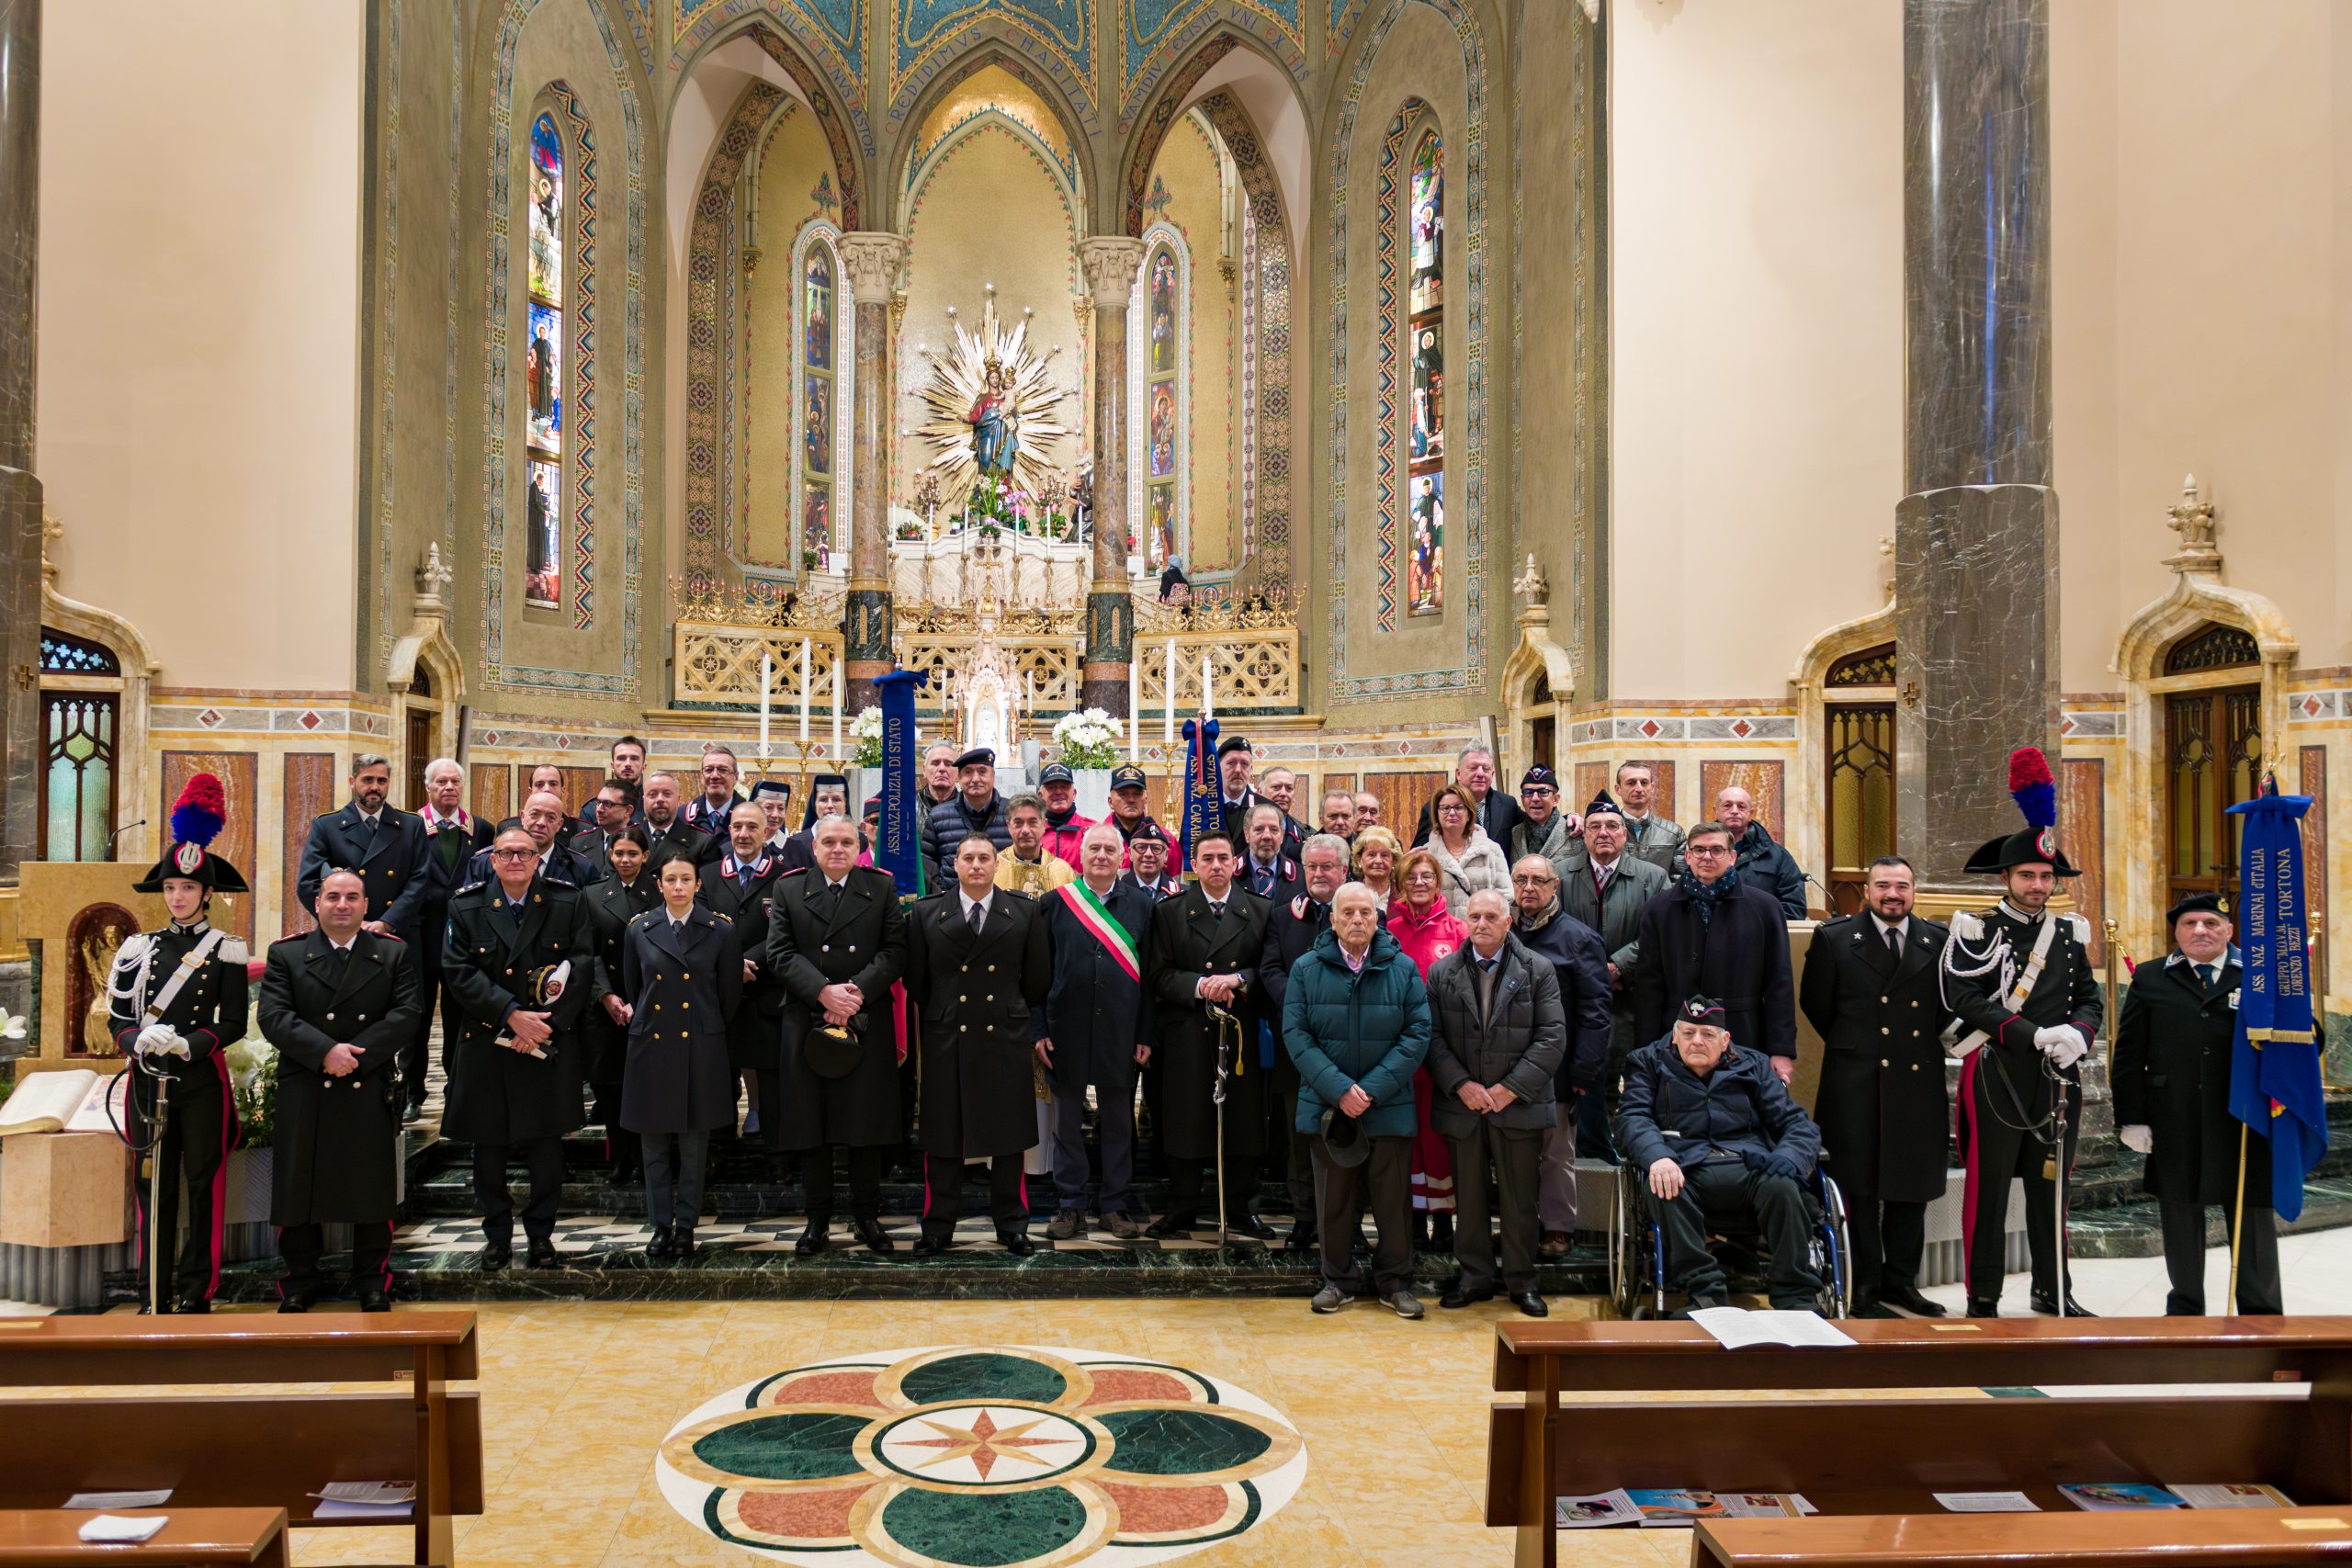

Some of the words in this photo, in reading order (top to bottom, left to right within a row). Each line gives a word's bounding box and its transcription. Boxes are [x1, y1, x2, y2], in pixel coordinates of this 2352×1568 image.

[621, 0, 655, 76] ANDA
[667, 51, 687, 73] VT
[685, 17, 717, 49] FIAT
[767, 0, 809, 39] OVILE
[808, 39, 828, 58] ET
[826, 53, 854, 98] VNVS
[848, 98, 876, 158] PASTOR
[885, 27, 981, 136] CREDIDIMVS
[1005, 28, 1102, 137] CHARITATI
[1117, 61, 1163, 135] QVAMDIV
[1163, 6, 1220, 60] FECISTIS
[1231, 6, 1259, 30] VNI
[1264, 27, 1286, 50] EX
[1286, 51, 1310, 83] HIS
[888, 717, 901, 753] STATO
[888, 755, 901, 767] DI
[1207, 800, 1219, 812] DI
[1209, 814, 1220, 830] TO
[2250, 847, 2265, 888] d'ITALIA
[2277, 847, 2294, 919] TORTONA
[2251, 893, 2265, 936] MARINAI
[2252, 944, 2265, 967] NAZ.
[2290, 955, 2304, 997] LORENZO
[2252, 973, 2265, 994] ASS.
[2278, 961, 2291, 996] GRUPPO
